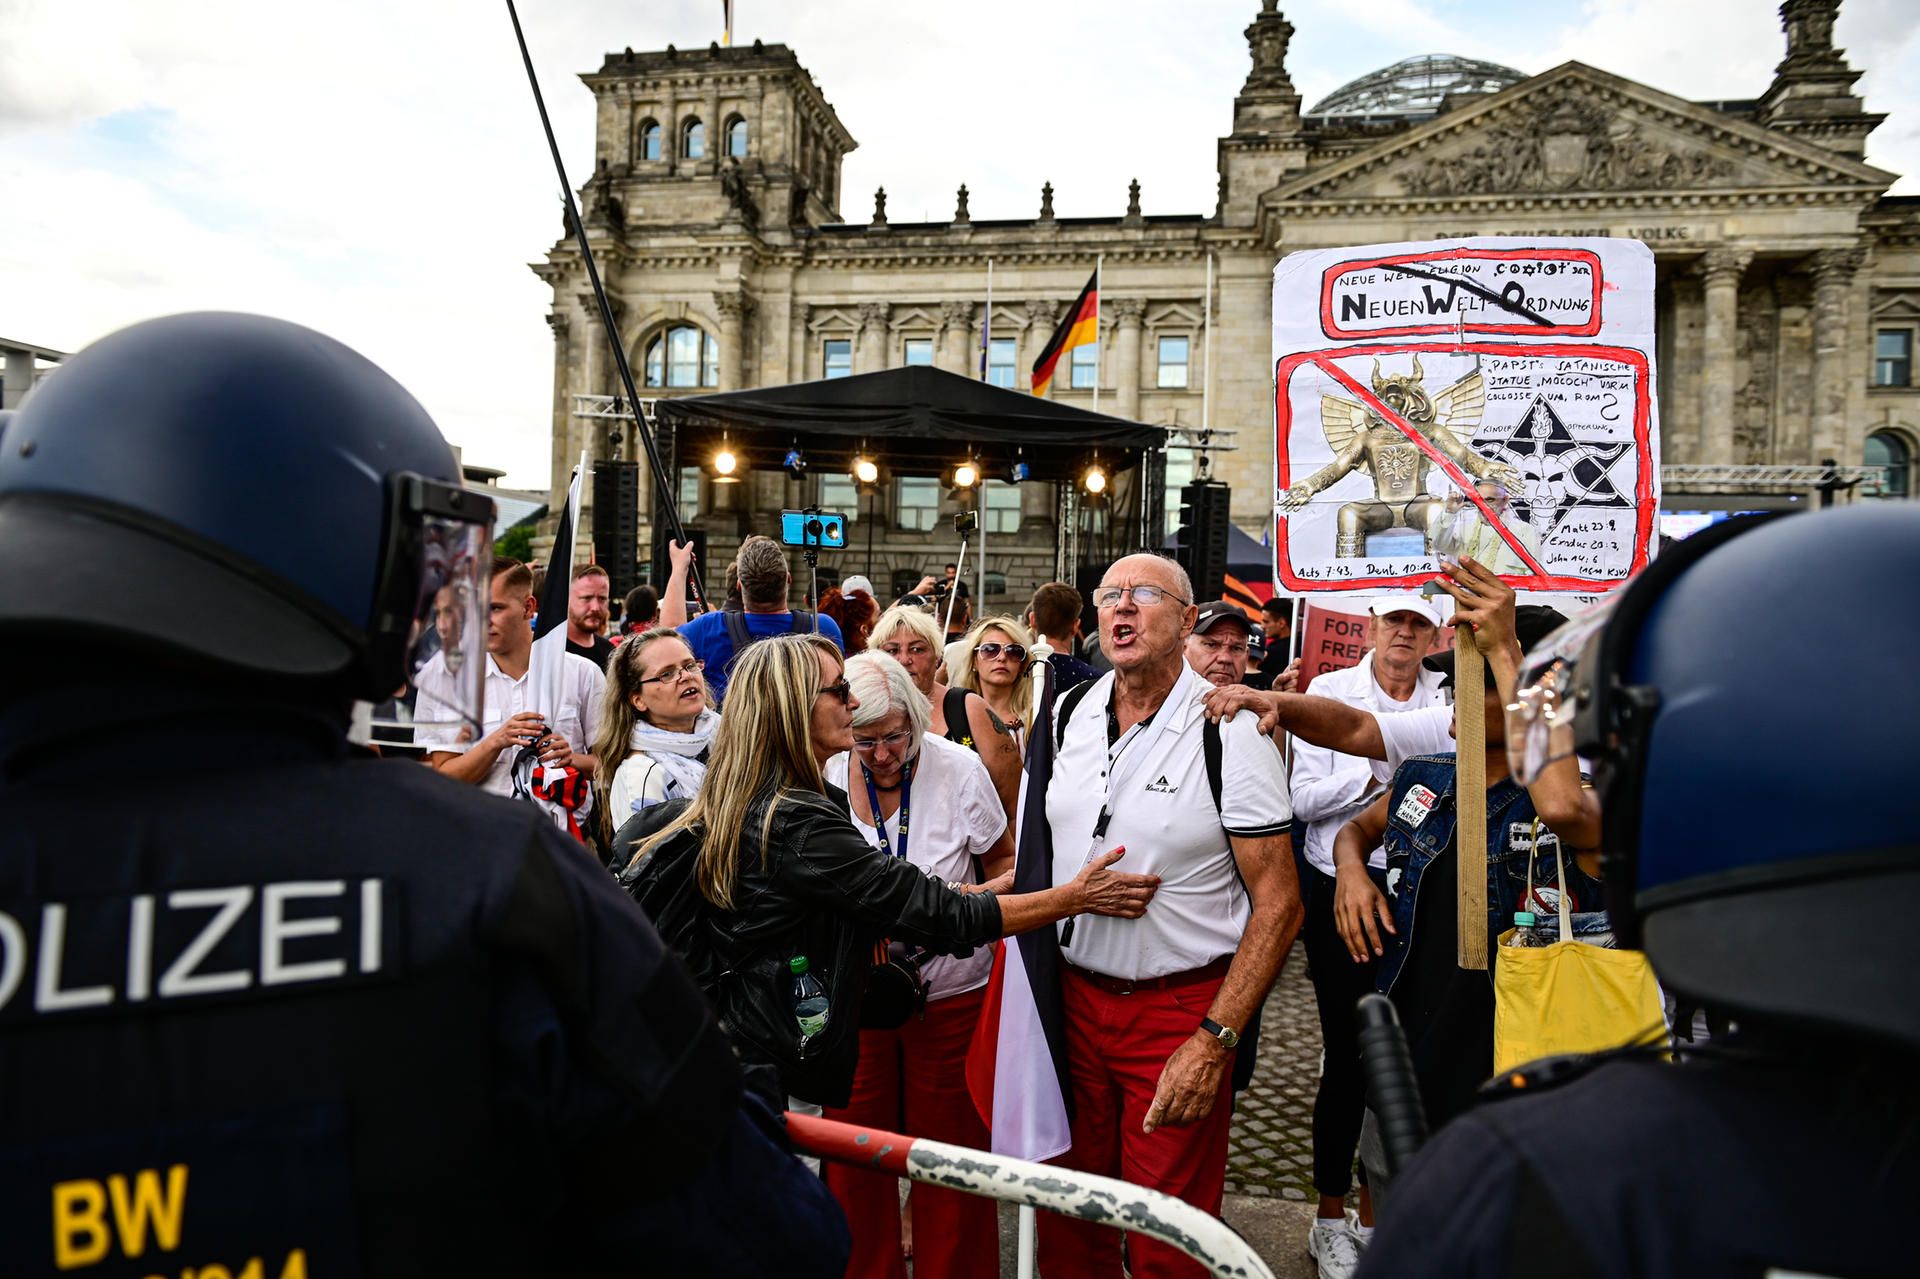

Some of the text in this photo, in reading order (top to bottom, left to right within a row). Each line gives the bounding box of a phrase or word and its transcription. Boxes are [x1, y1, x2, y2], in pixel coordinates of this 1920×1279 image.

[1628, 227, 1689, 239] VOLKE
[1340, 275, 1375, 286] NEUE
[1555, 360, 1630, 372] SATANISCHE
[1489, 376, 1530, 386] STATUE
[1561, 523, 1589, 534] Matt
[1298, 568, 1319, 578] Acts
[1325, 565, 1353, 577] 7:43,
[1324, 617, 1364, 638] FOR
[53, 1164, 189, 1270] BW
